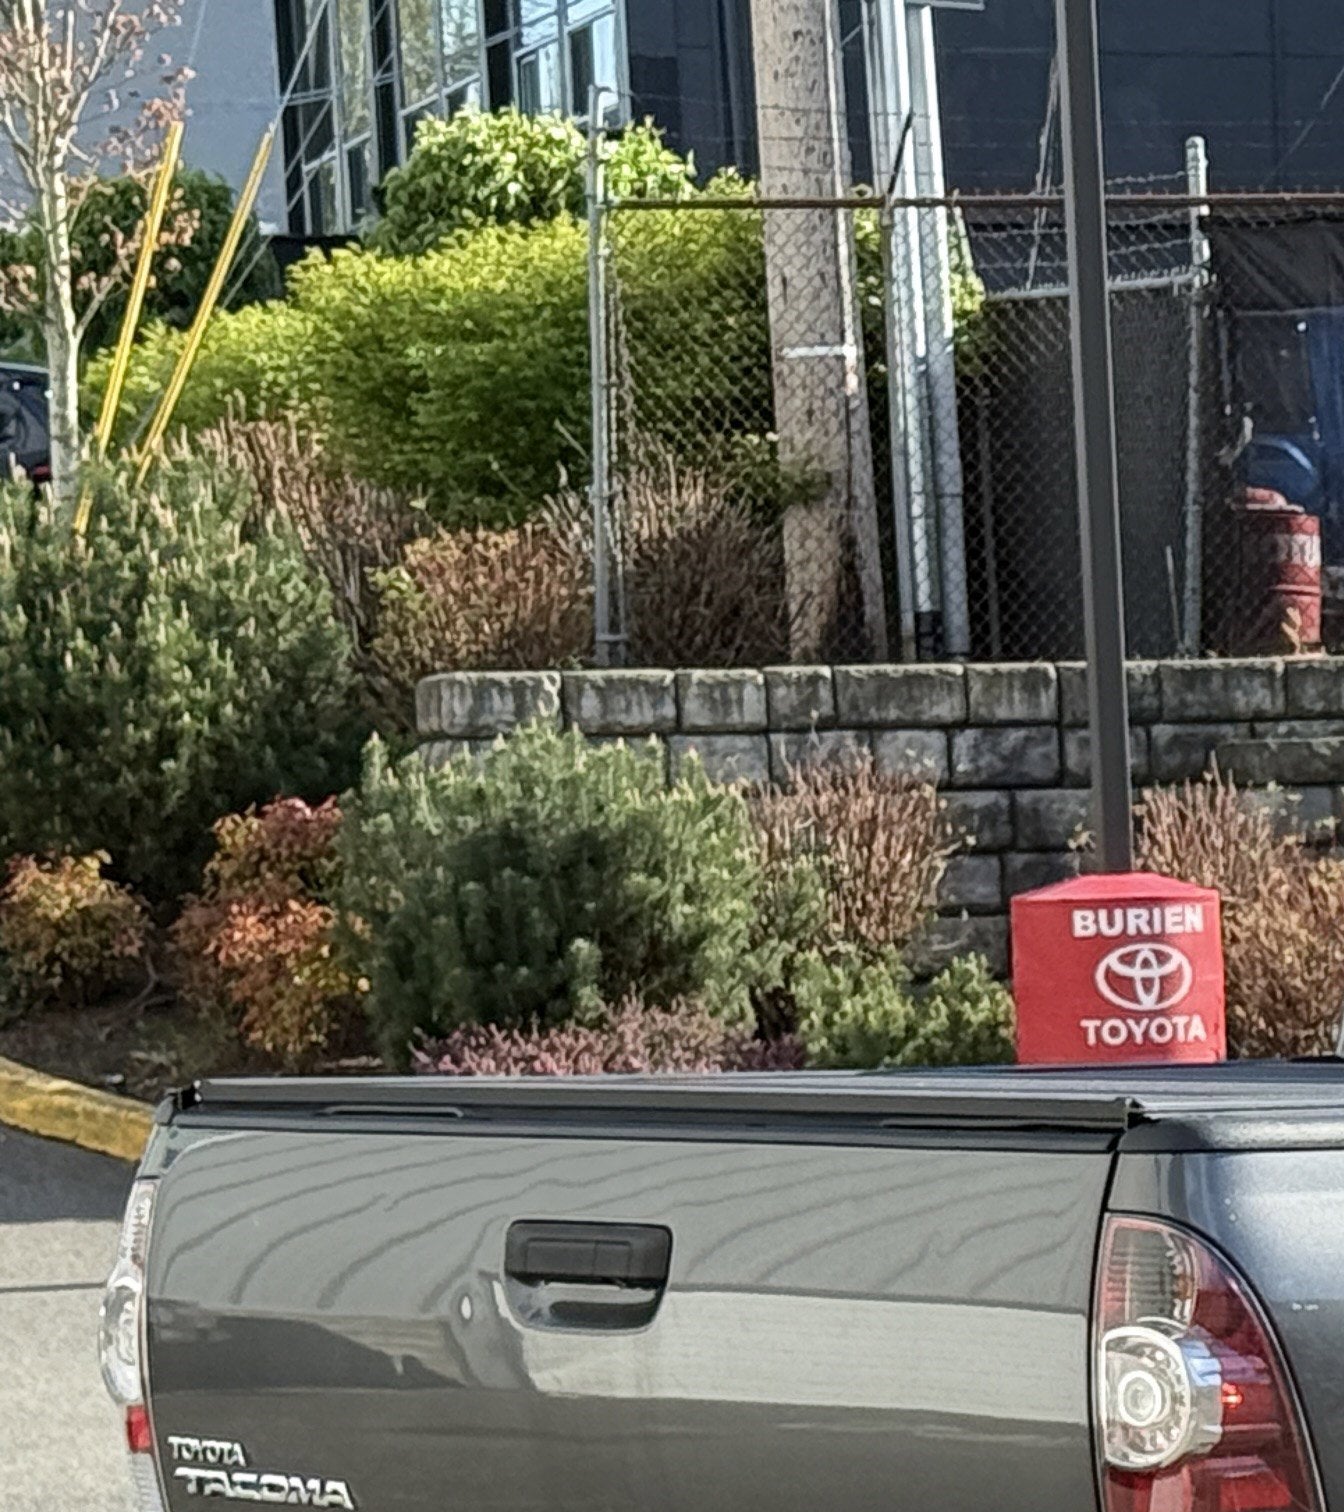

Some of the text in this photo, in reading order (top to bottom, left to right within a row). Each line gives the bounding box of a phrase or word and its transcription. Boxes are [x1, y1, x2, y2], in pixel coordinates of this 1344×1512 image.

[1072, 904, 1204, 937] BURIEN
[1080, 1014, 1207, 1046] TOYOTA
[168, 1435, 247, 1467] TOYOTA
[174, 1467, 355, 1510] TACOMA
